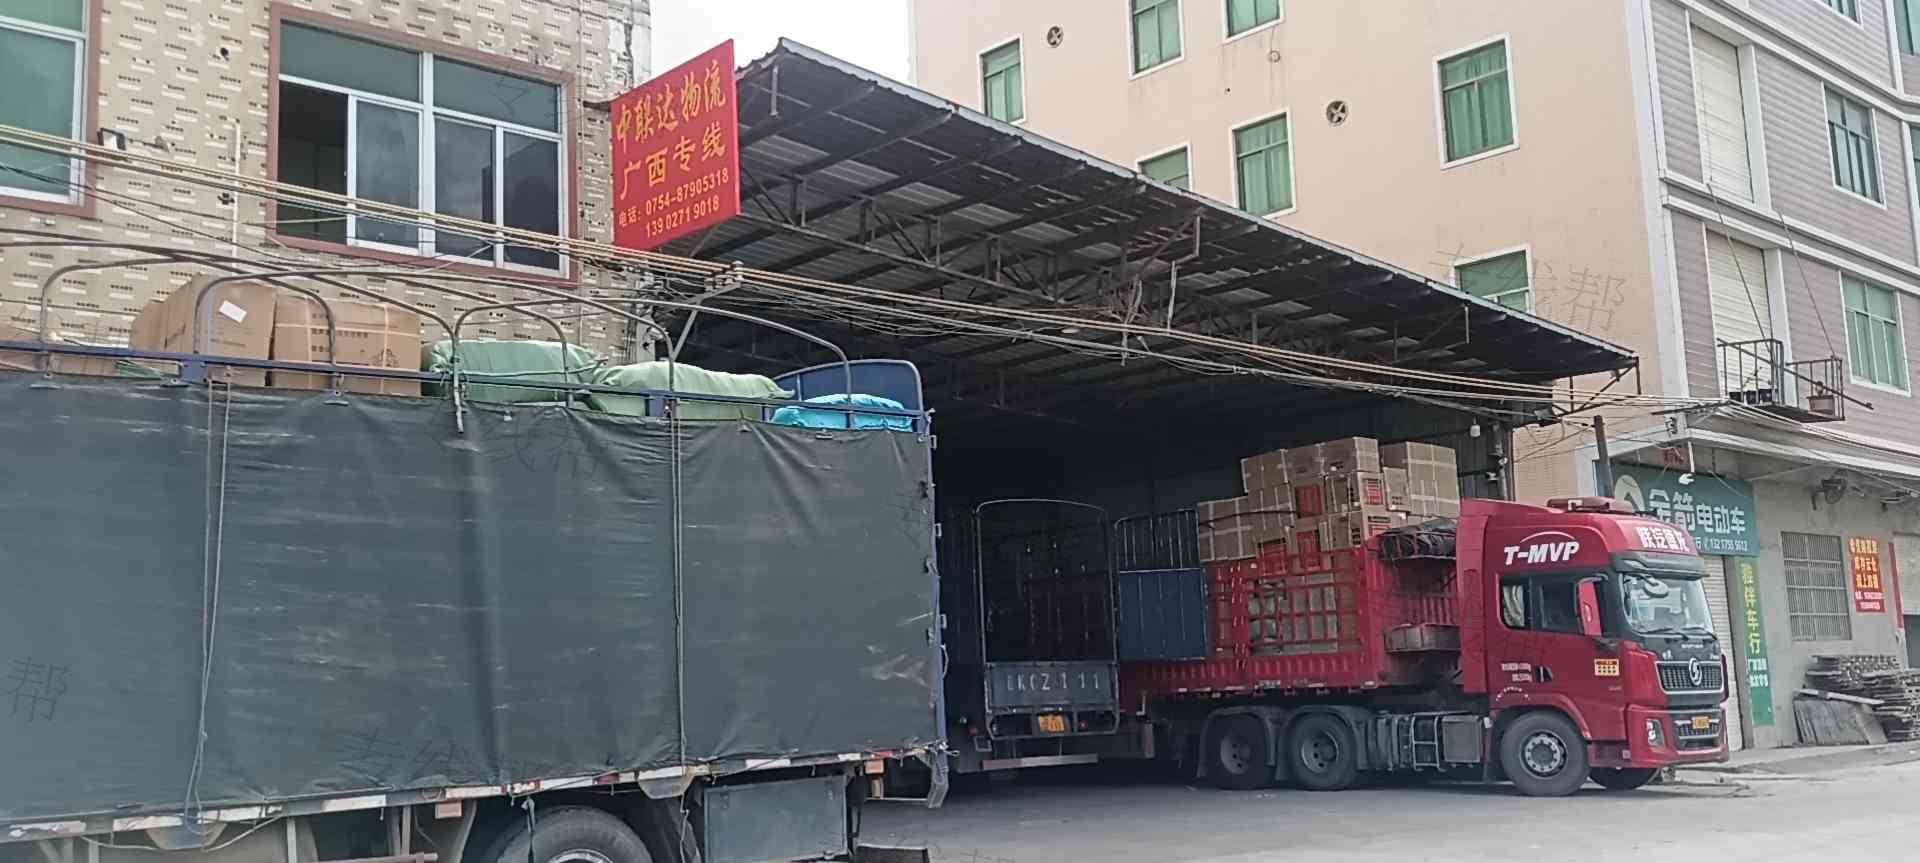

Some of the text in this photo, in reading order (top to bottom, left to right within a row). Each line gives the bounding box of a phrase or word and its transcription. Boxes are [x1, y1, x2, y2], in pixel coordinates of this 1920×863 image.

[615, 58, 727, 153] 中联达物流
[619, 121, 726, 201] 广西专线
[1649, 488, 1747, 536] 金箭电动车
[1504, 541, 1580, 565] T-MVP
